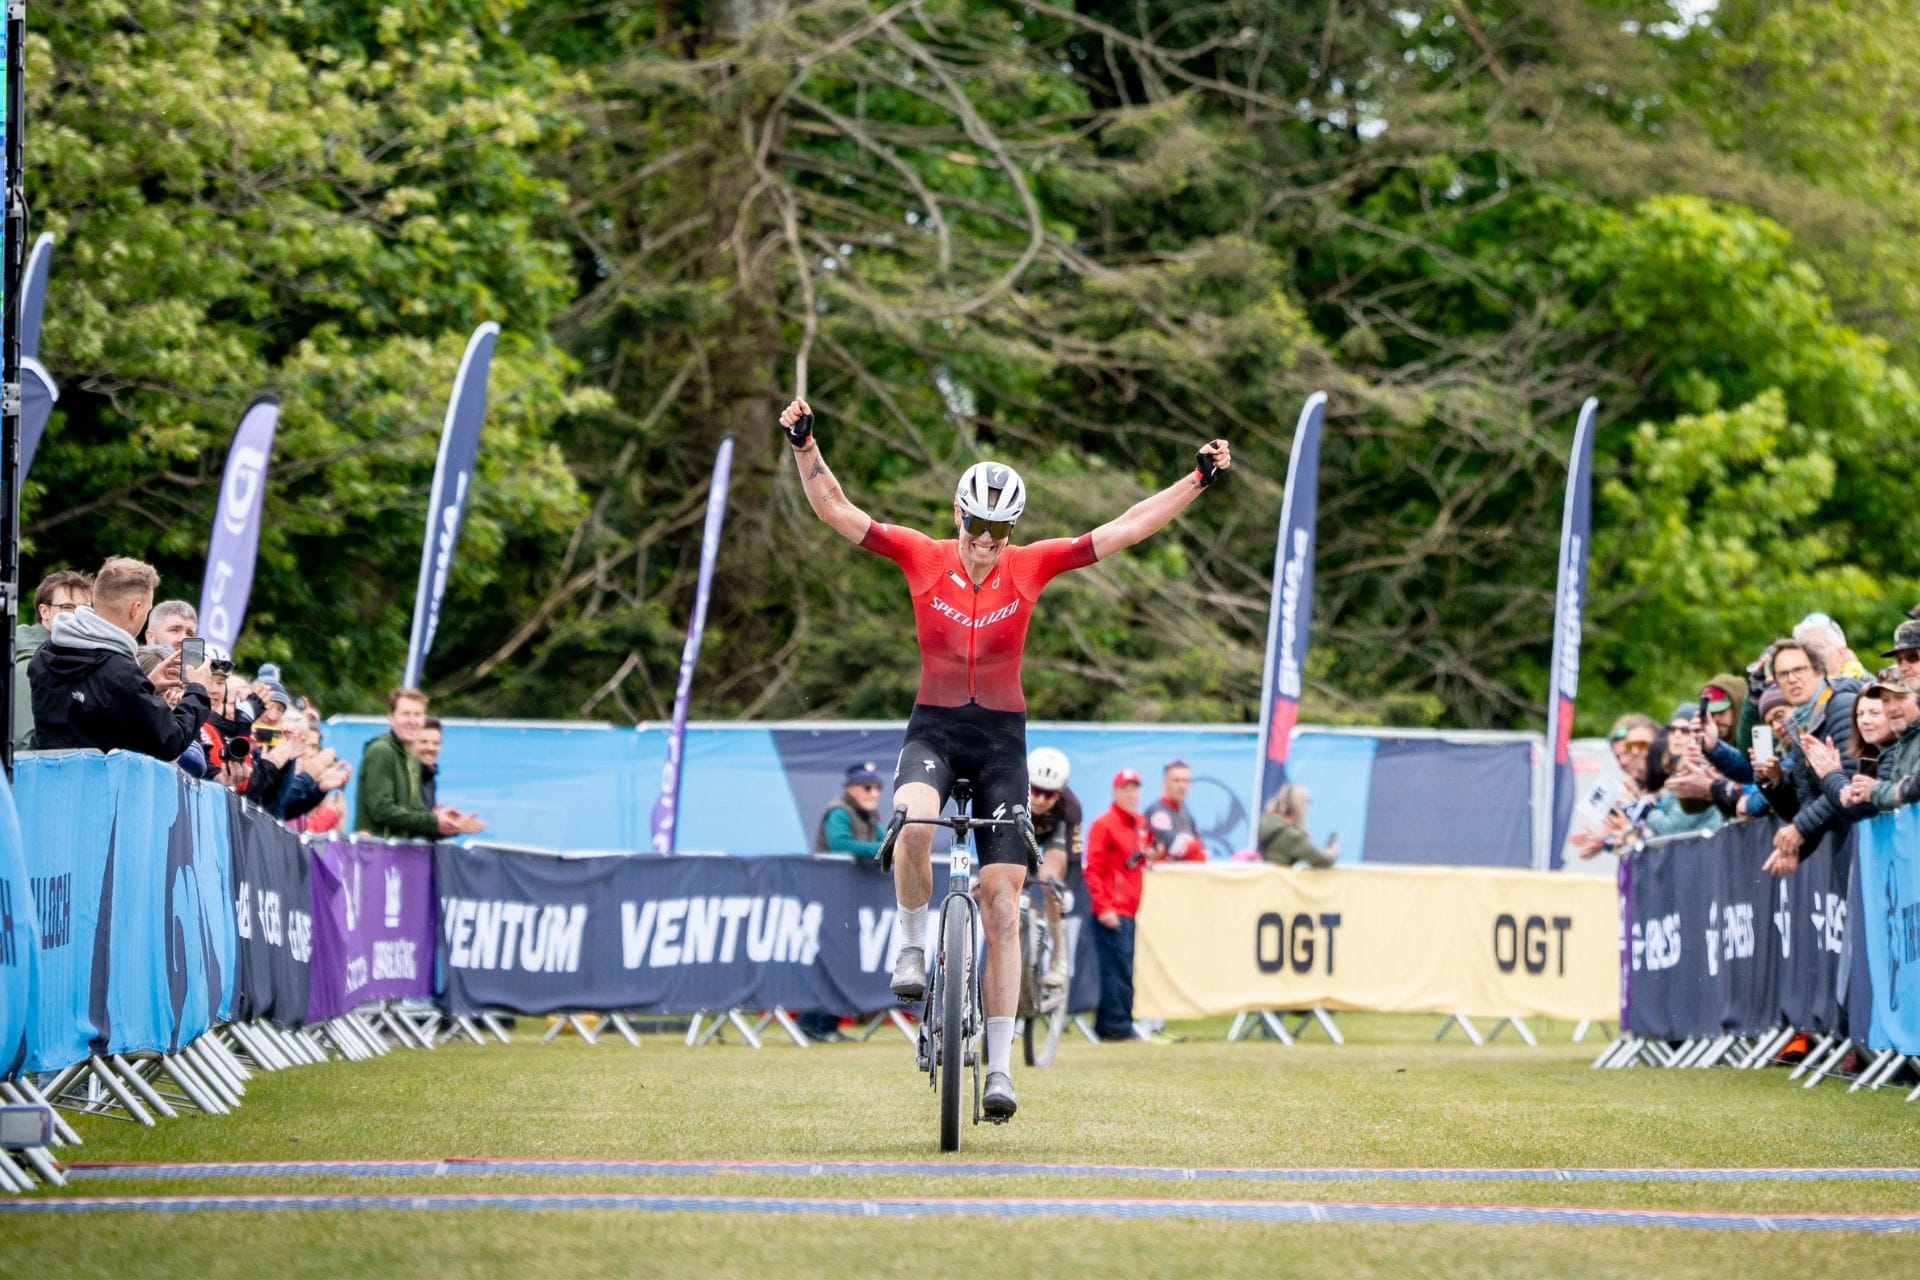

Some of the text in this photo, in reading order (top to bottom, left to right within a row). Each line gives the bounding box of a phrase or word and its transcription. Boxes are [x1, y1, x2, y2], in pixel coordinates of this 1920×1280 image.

[930, 596, 1020, 629] SPECIALIZED
[953, 856, 969, 870] 19
[620, 895, 824, 970] VENTUM
[1256, 911, 1342, 976] OGT
[1494, 913, 1572, 976] OGT
